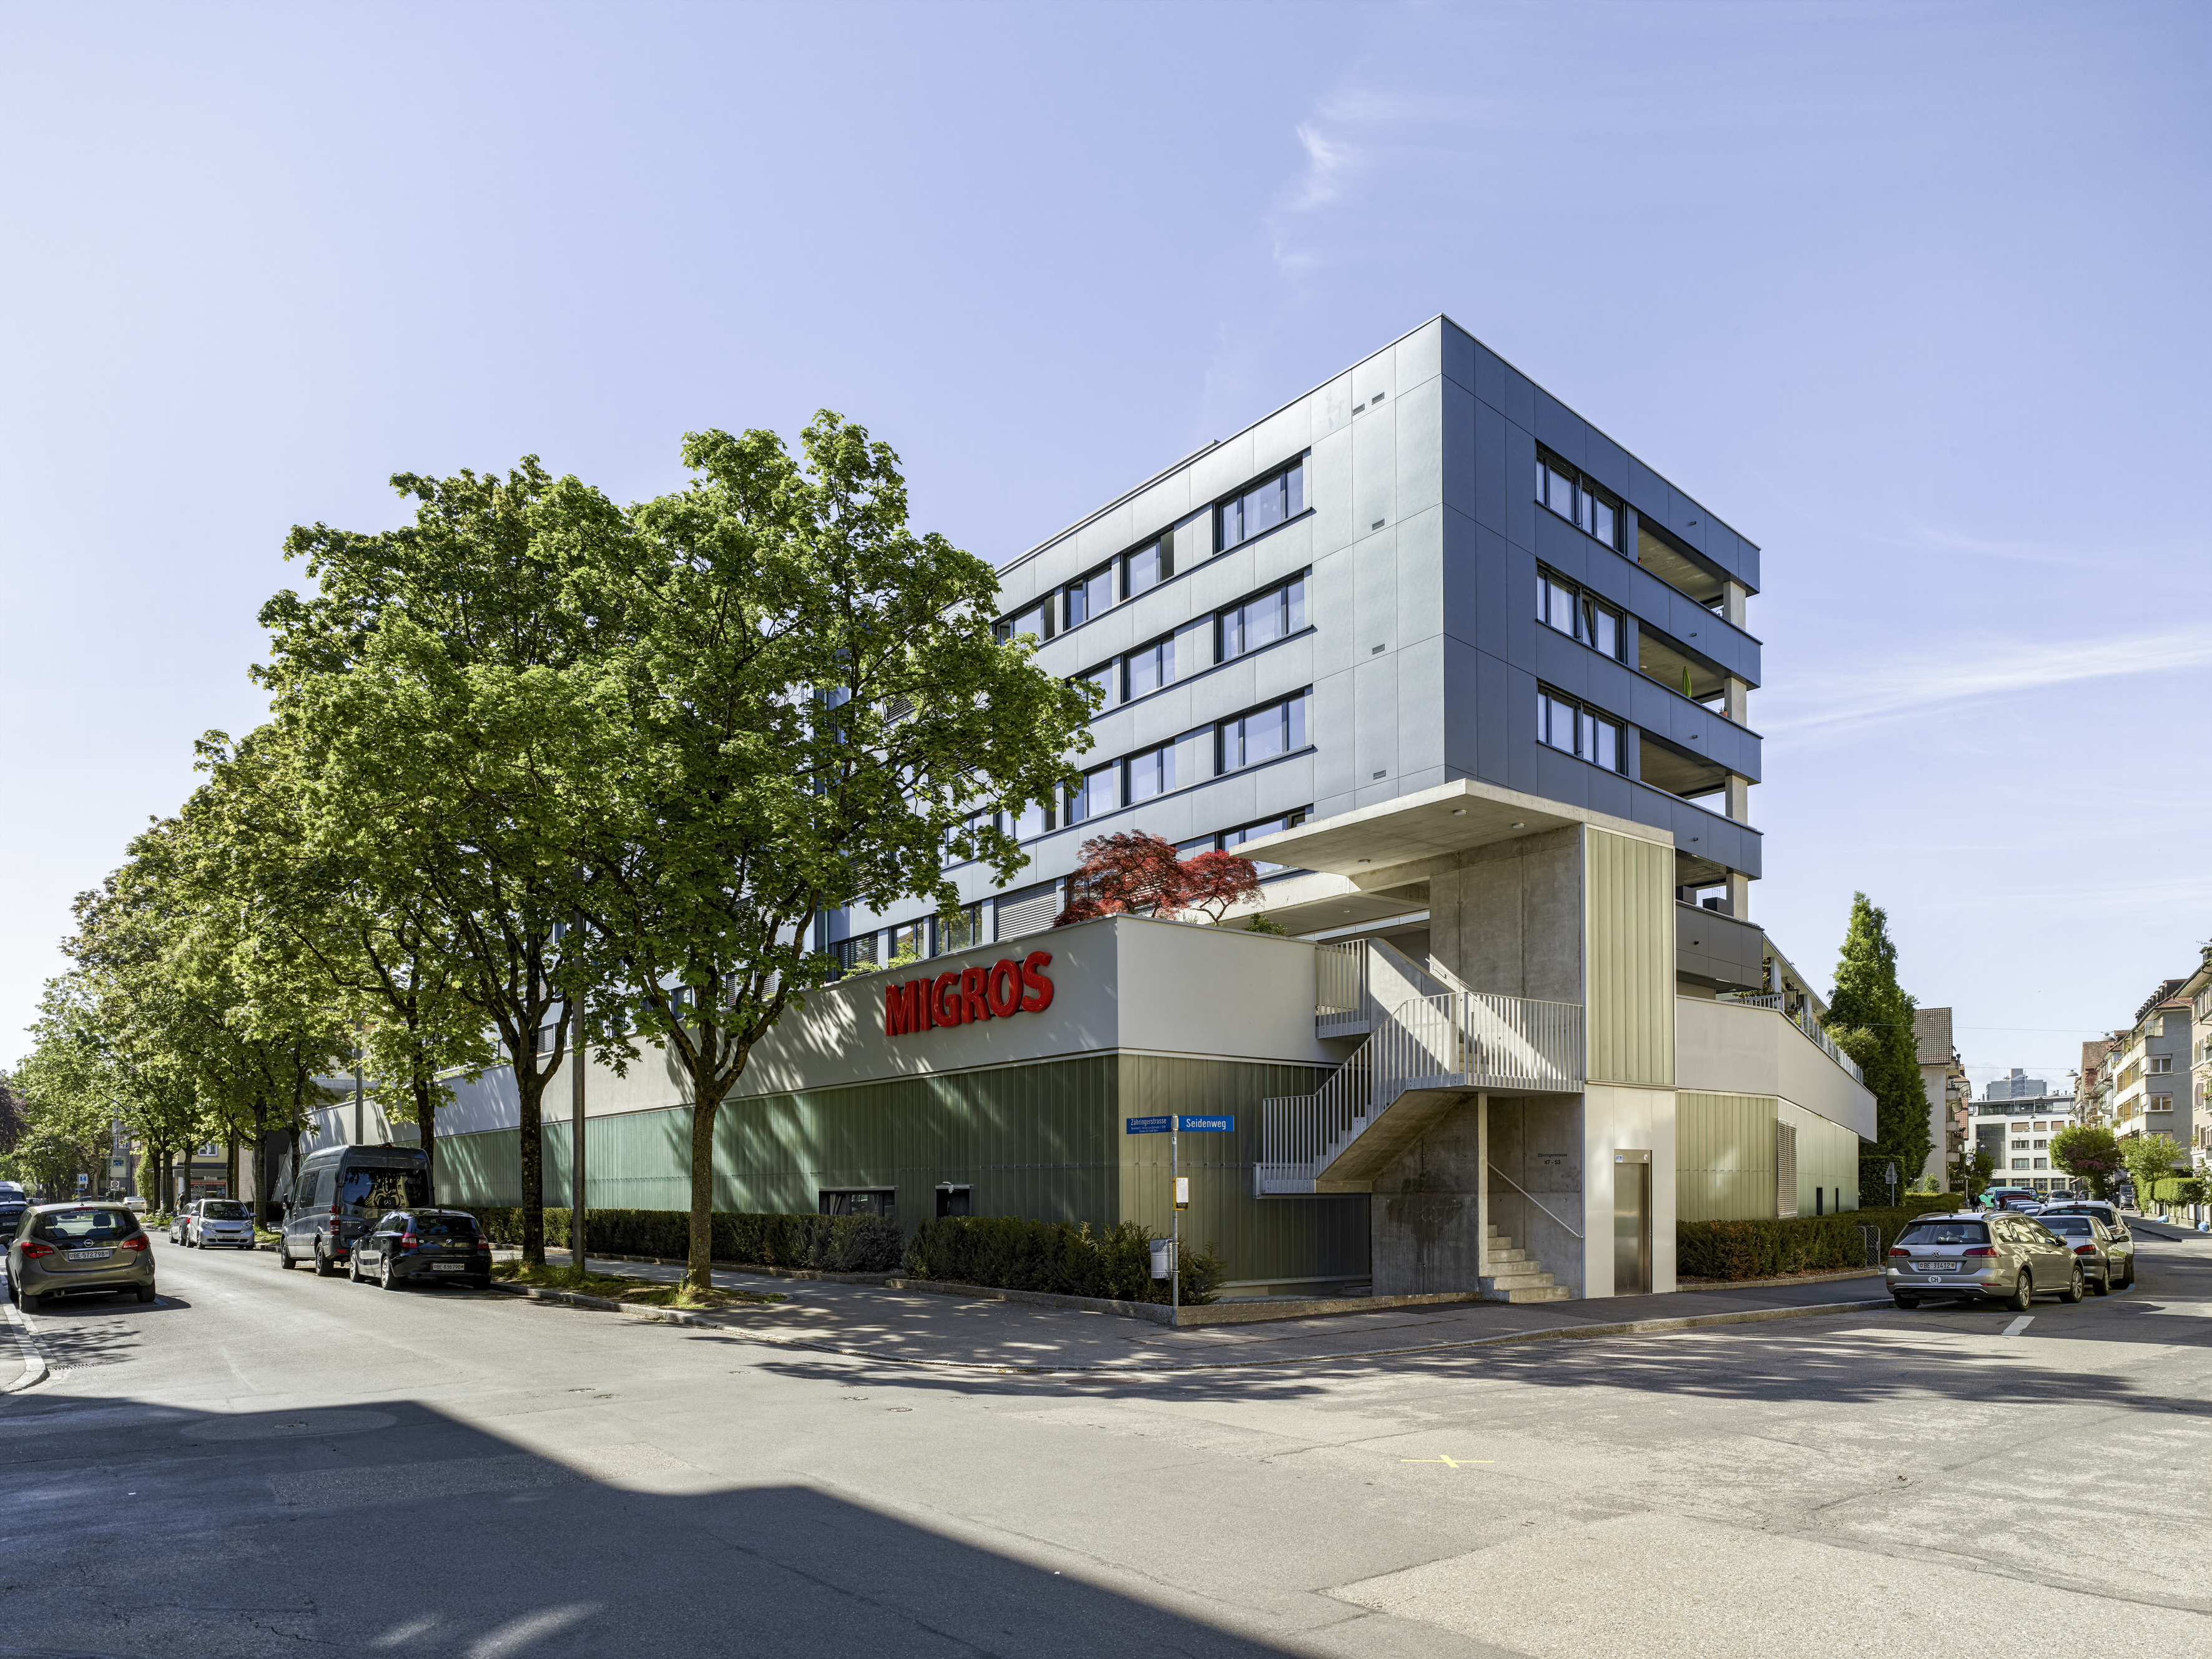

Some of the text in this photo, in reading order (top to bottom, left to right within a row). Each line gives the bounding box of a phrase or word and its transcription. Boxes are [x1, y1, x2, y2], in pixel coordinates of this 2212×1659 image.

[885, 951, 1053, 1036] MIGROS
[1131, 1118, 1167, 1127] Zähringerstrasse
[1186, 1118, 1226, 1130] Seidenweg
